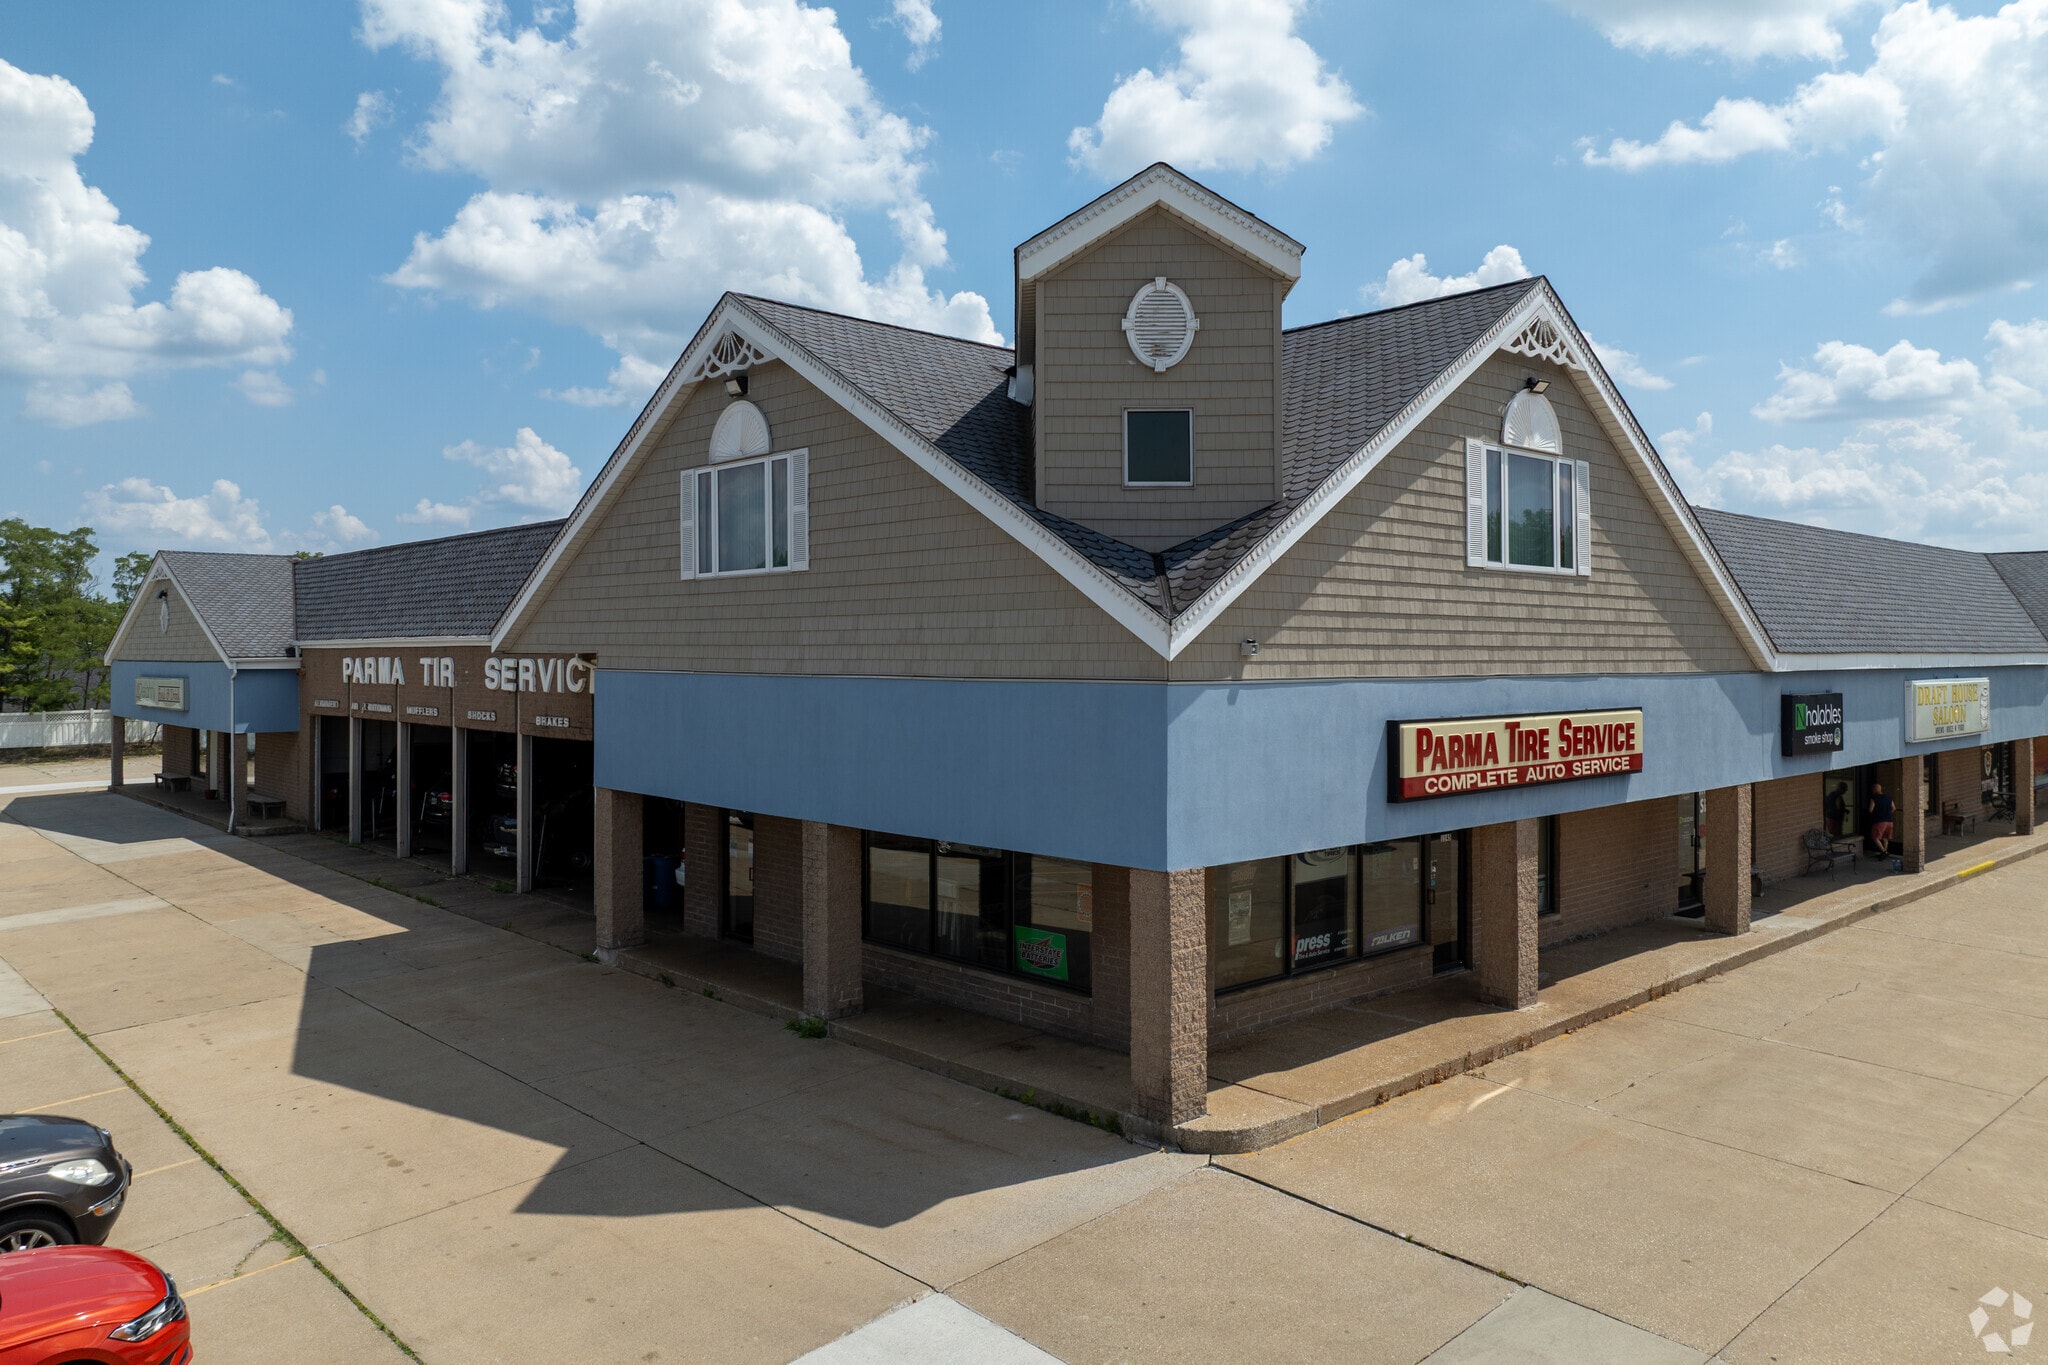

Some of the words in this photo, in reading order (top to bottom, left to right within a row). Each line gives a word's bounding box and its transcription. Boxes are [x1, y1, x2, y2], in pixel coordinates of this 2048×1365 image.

[343, 657, 405, 685] PARMA
[420, 657, 455, 688] TIR
[485, 657, 594, 693] SERVIC
[1917, 685, 1947, 706] DRAFT
[1951, 684, 1978, 703] HOUSE
[406, 705, 439, 716] MUFFLERS
[467, 710, 496, 721] SHOCKS
[1933, 705, 1967, 726] SALOON
[535, 716, 569, 728] BRAKES
[1416, 727, 1499, 773] PARMA
[1505, 721, 1550, 763] TIRE
[1558, 718, 1636, 758] SERVICE
[1804, 732, 1821, 745] smoke
[1821, 731, 1833, 745] shop
[1425, 768, 1518, 793] COMPLETE
[1525, 764, 1566, 782] AUTO
[1572, 756, 1630, 776] SERVICE
[1371, 930, 1411, 946] FALKEN
[1019, 942, 1061, 958] INTERSTATE
[1021, 951, 1058, 965] BATTERIES
